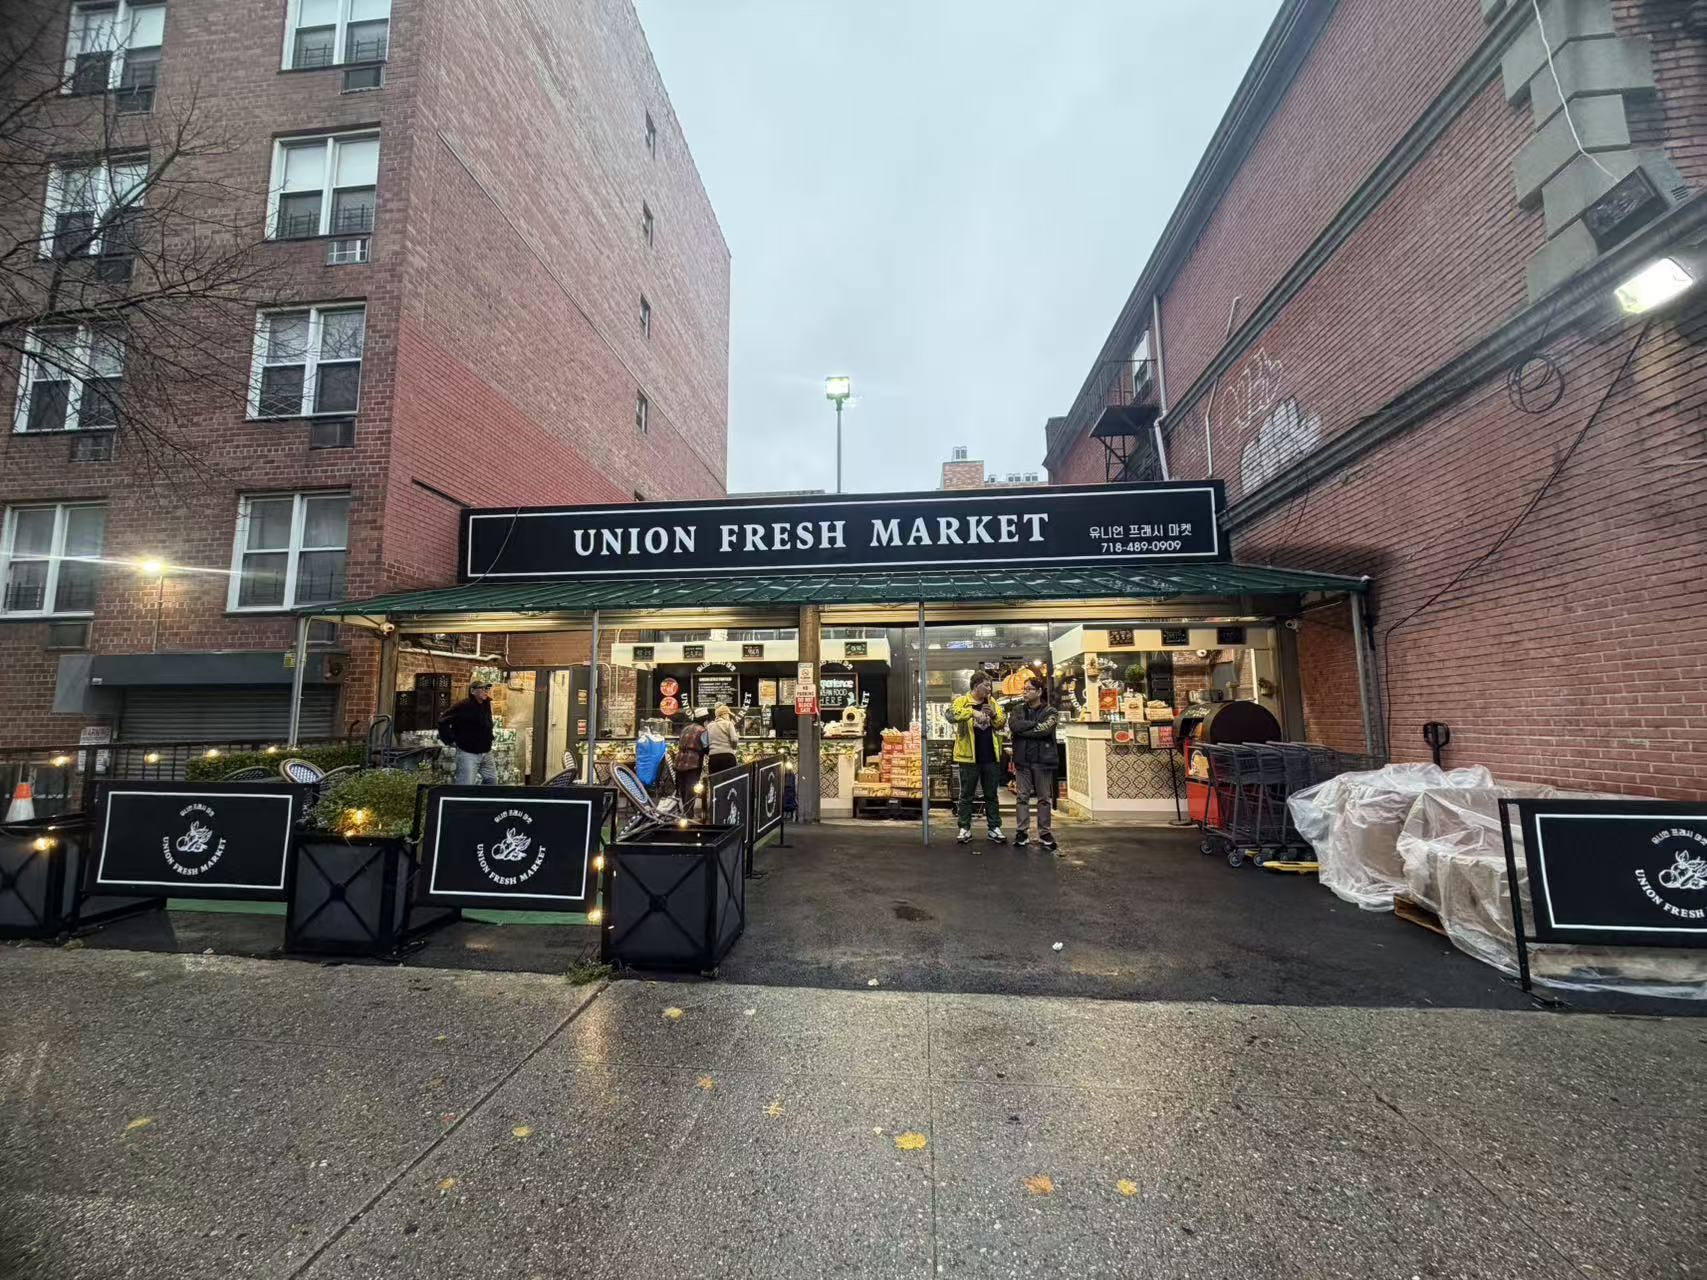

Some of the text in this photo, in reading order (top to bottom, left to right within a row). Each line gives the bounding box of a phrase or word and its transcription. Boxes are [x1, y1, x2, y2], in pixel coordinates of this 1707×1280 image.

[573, 513, 1049, 556] UNION FRESH MARKET
[1089, 525, 1124, 539] 유니언
[1168, 522, 1192, 537] 마켓
[1101, 540, 1182, 553] 718-489-0909
[162, 836, 227, 876] UNION FRESH MARKET
[476, 843, 547, 886] UNION FRESH MARKET
[1634, 869, 1705, 919] UNION FRESH
